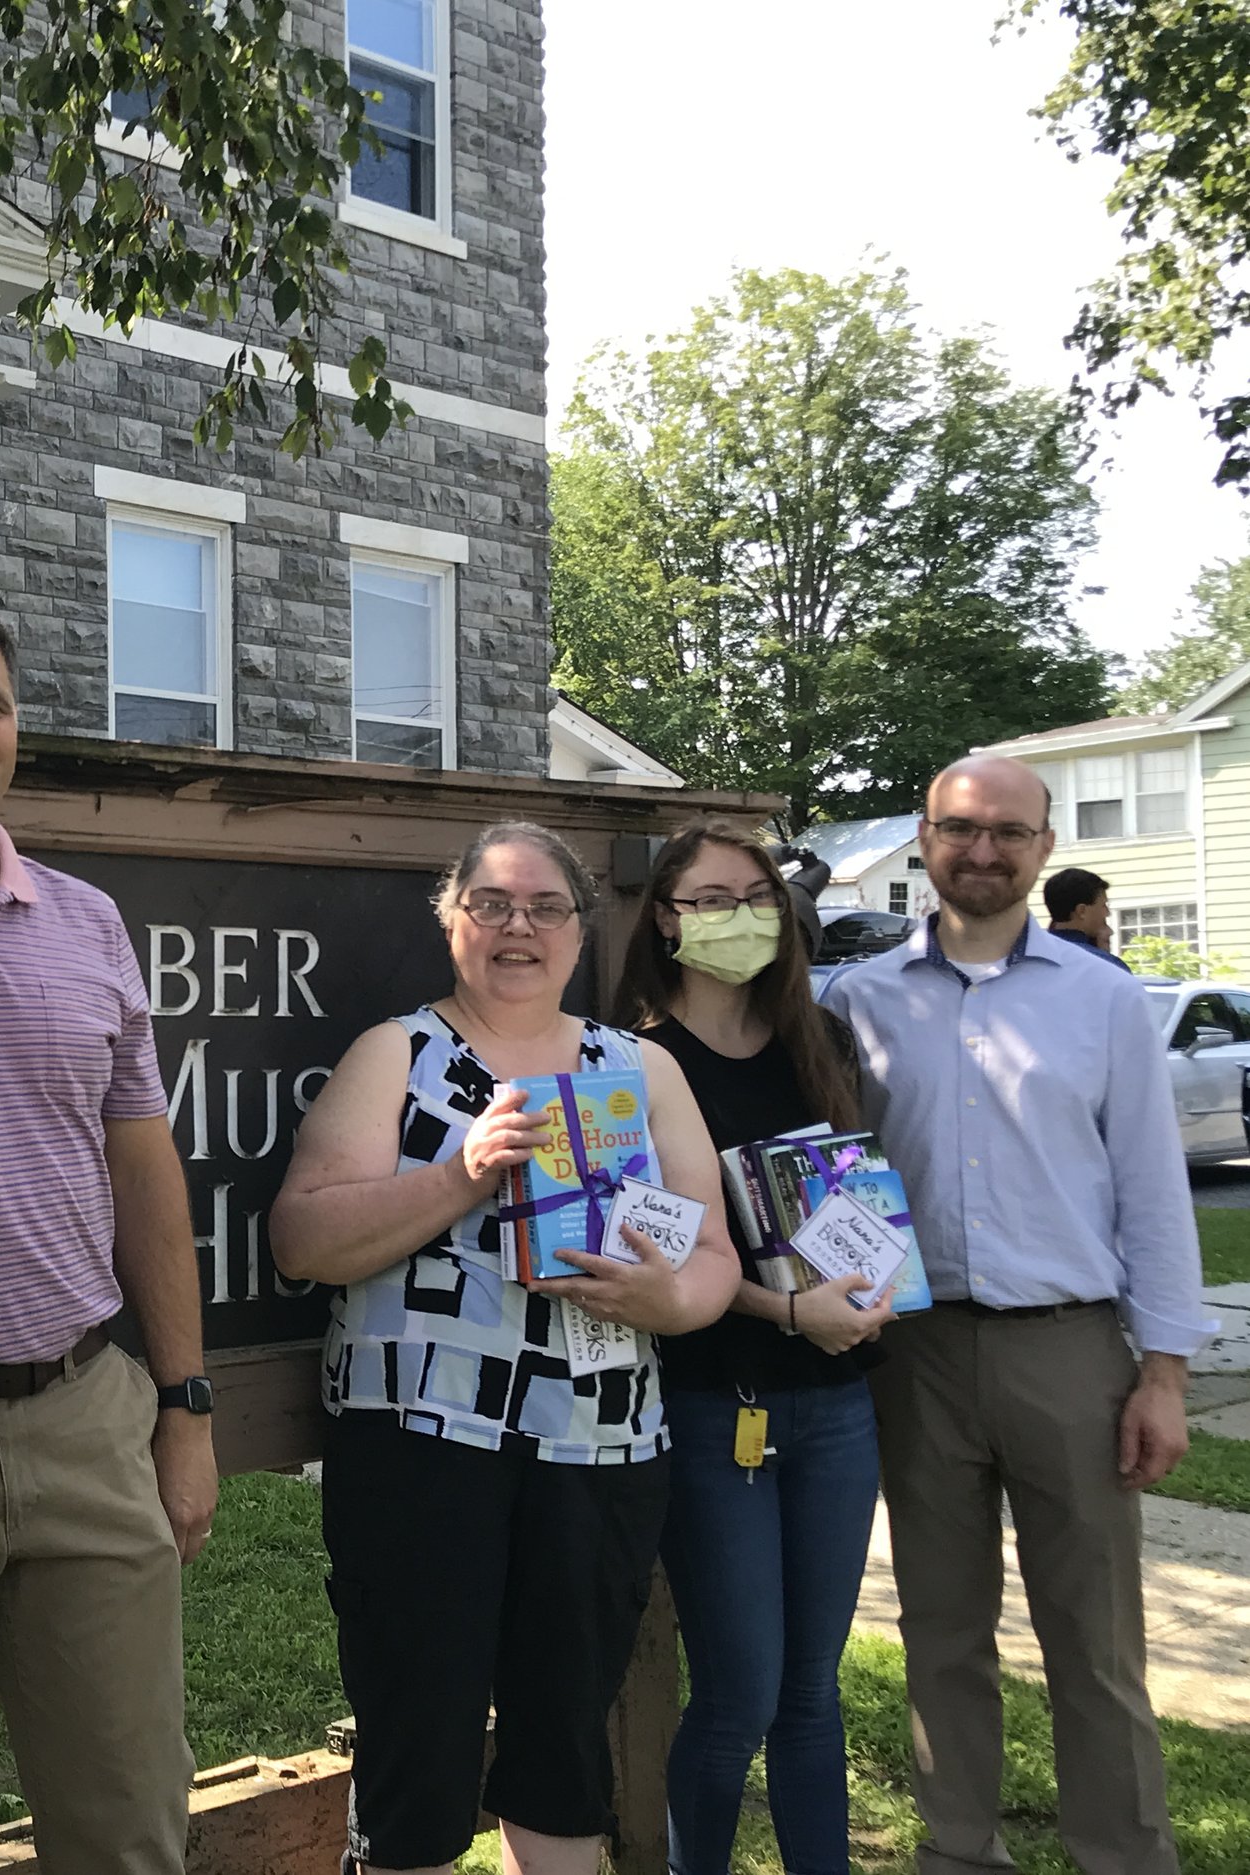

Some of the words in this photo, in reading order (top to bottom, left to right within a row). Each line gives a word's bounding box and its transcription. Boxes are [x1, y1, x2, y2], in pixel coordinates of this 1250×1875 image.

[146, 923, 330, 1019] BER
[546, 1105, 594, 1127] Te
[582, 1127, 643, 1151] Hour
[553, 1158, 602, 1180] Dy
[632, 1193, 682, 1219] Nana's
[194, 1179, 318, 1304] HI
[838, 1215, 885, 1254] Nana's
[571, 1306, 584, 1361] UNDATION
